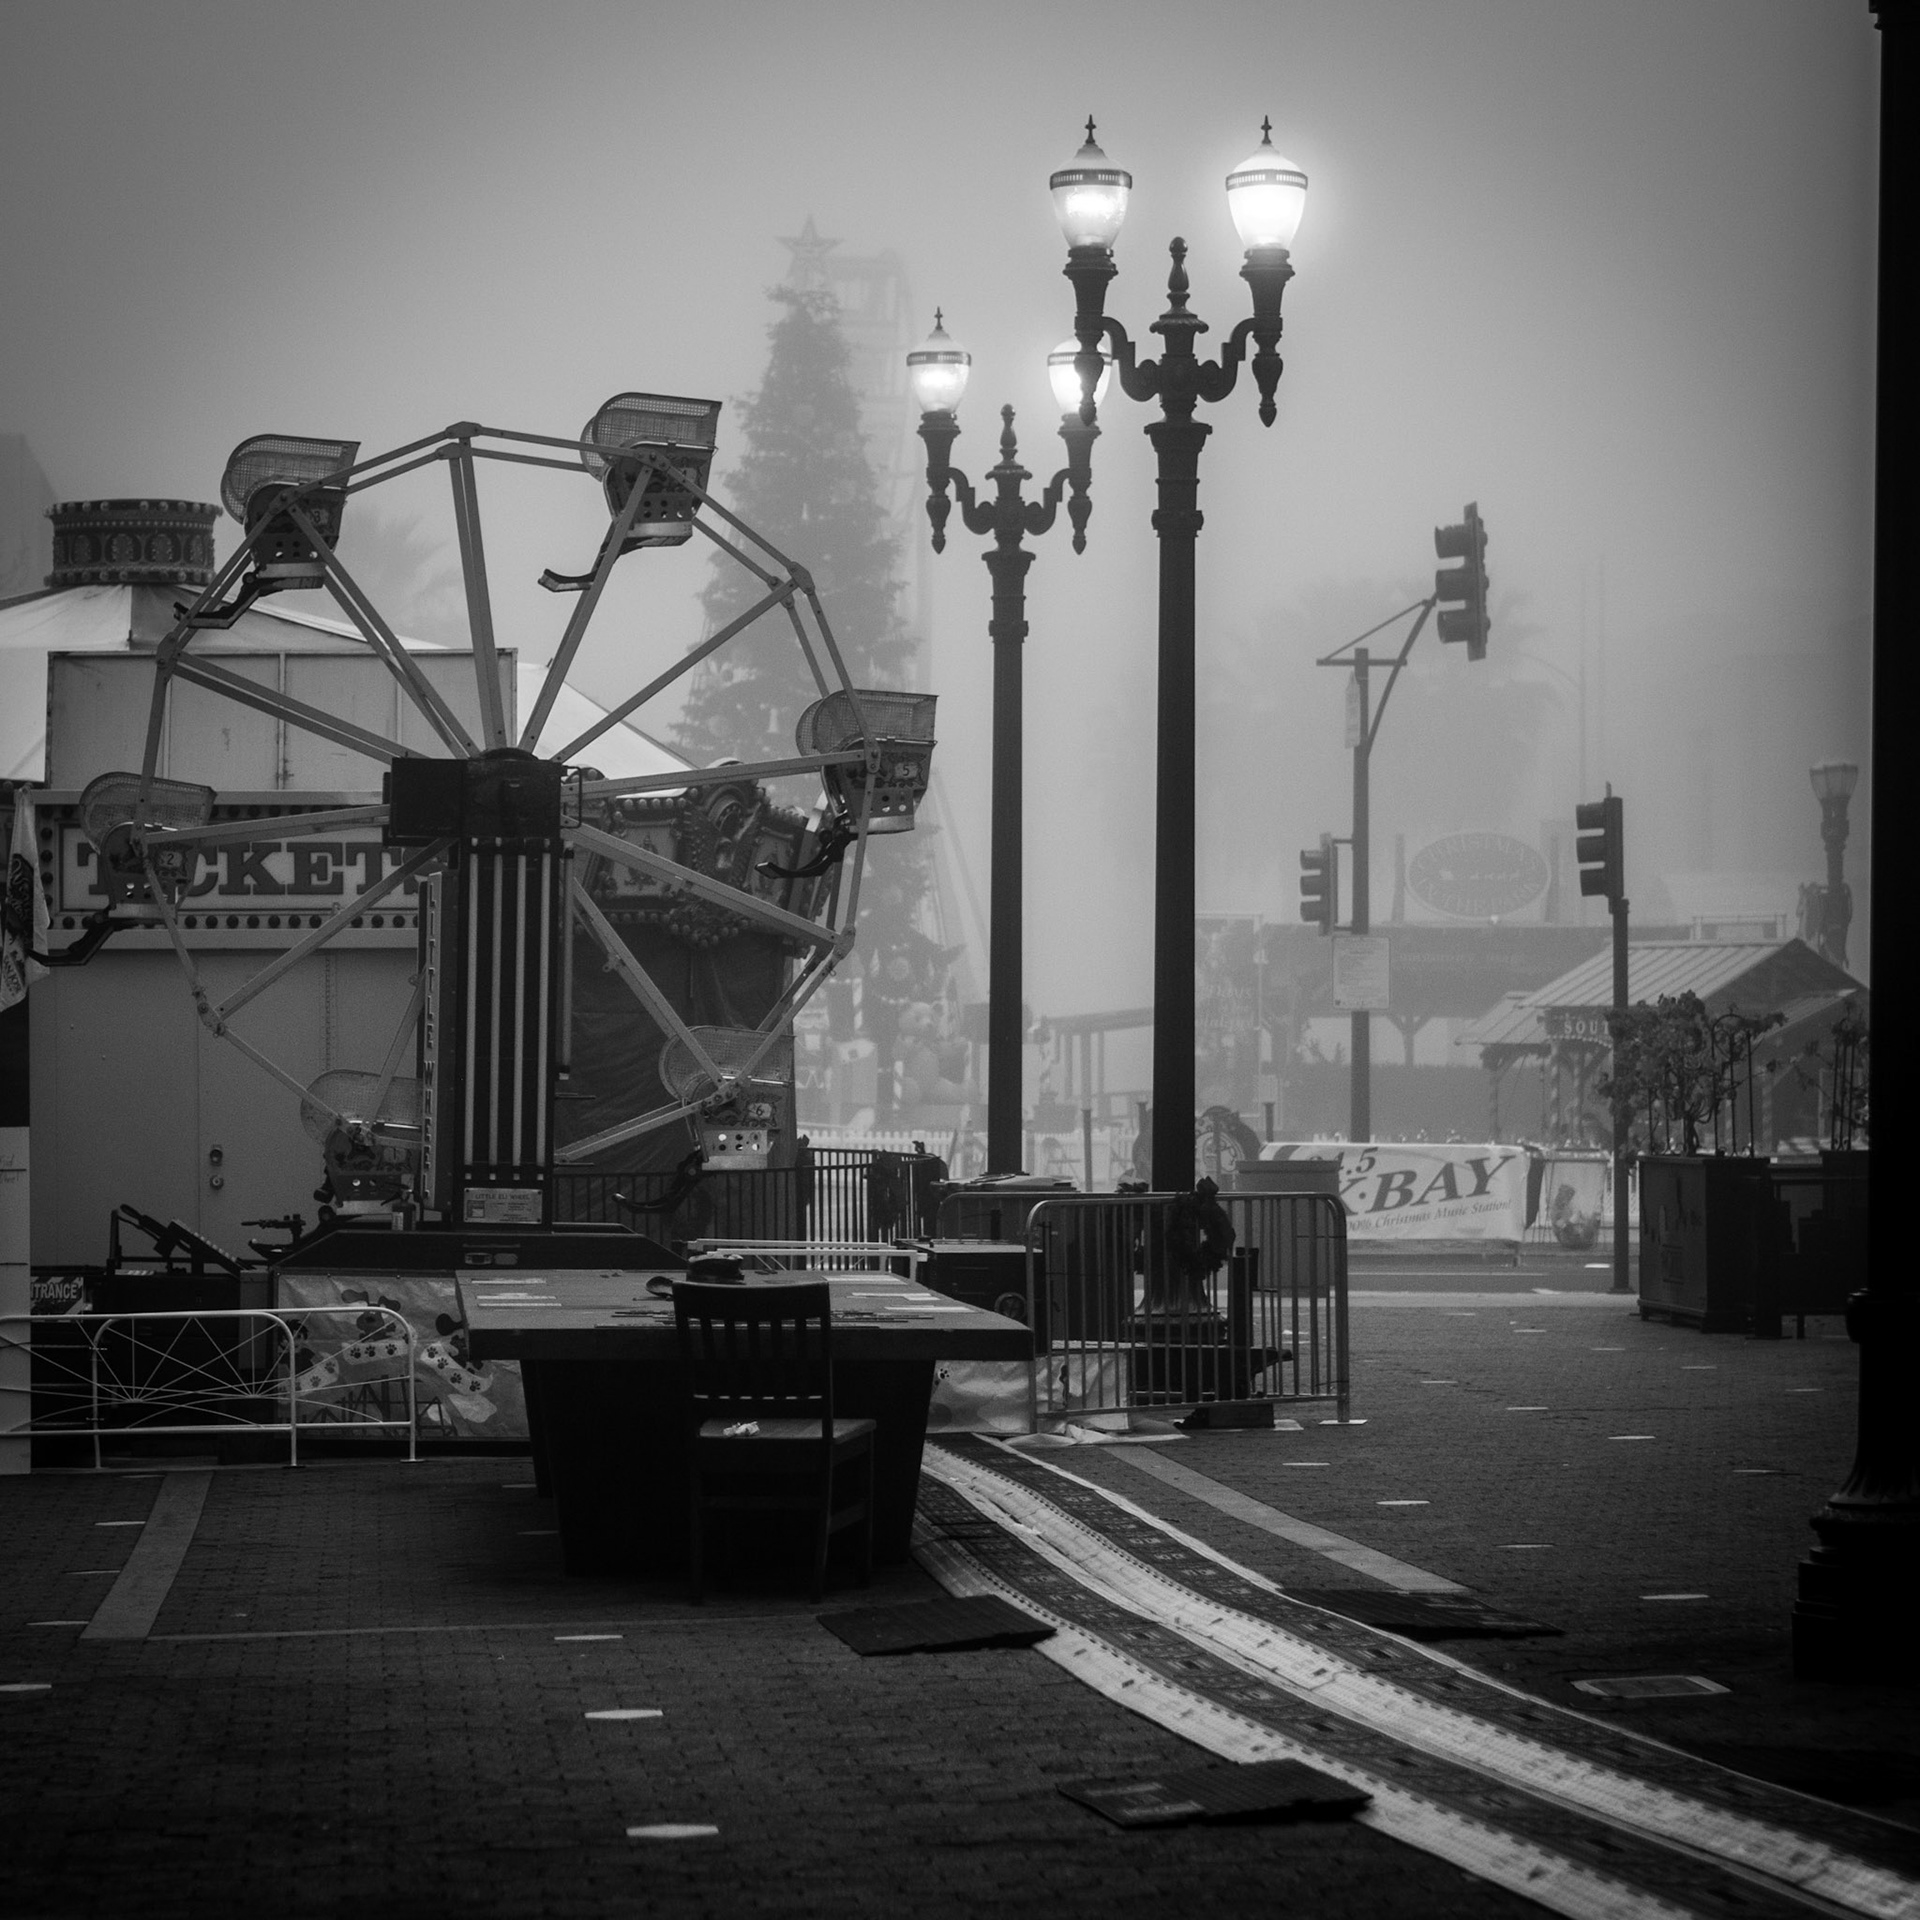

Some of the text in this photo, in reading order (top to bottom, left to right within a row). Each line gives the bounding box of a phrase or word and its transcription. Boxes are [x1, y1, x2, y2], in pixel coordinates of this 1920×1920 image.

[311, 510, 320, 525] 3
[902, 760, 911, 776] 5
[167, 853, 175, 866] 2
[77, 841, 447, 897] TCKET
[422, 883, 437, 1198] LITTLE WHEEL
[755, 1105, 765, 1117] 6
[1375, 1211, 1431, 1229] Christmas
[1434, 1204, 1467, 1220] Music
[31, 1283, 77, 1299] TRANCE
